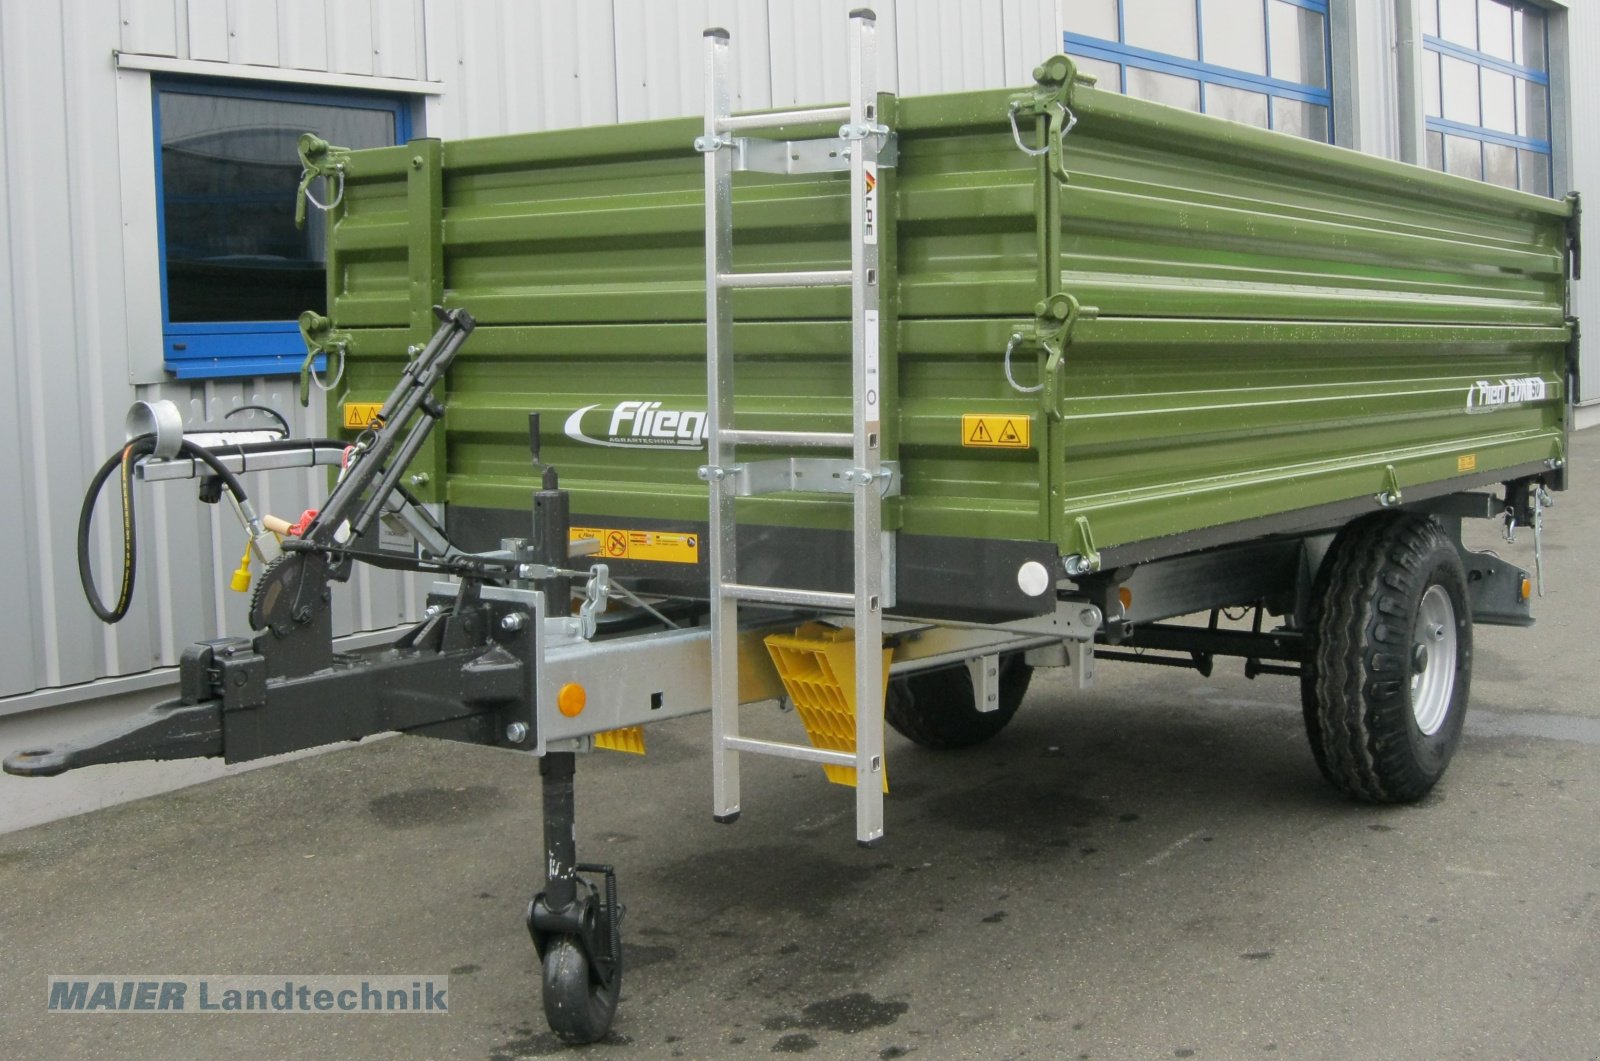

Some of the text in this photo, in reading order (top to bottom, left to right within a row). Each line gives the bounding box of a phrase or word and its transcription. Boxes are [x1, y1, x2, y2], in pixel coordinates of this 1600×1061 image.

[865, 181, 873, 236] ALPE
[608, 401, 709, 445] Flieg
[609, 437, 676, 445] AGRARTECHNIK
